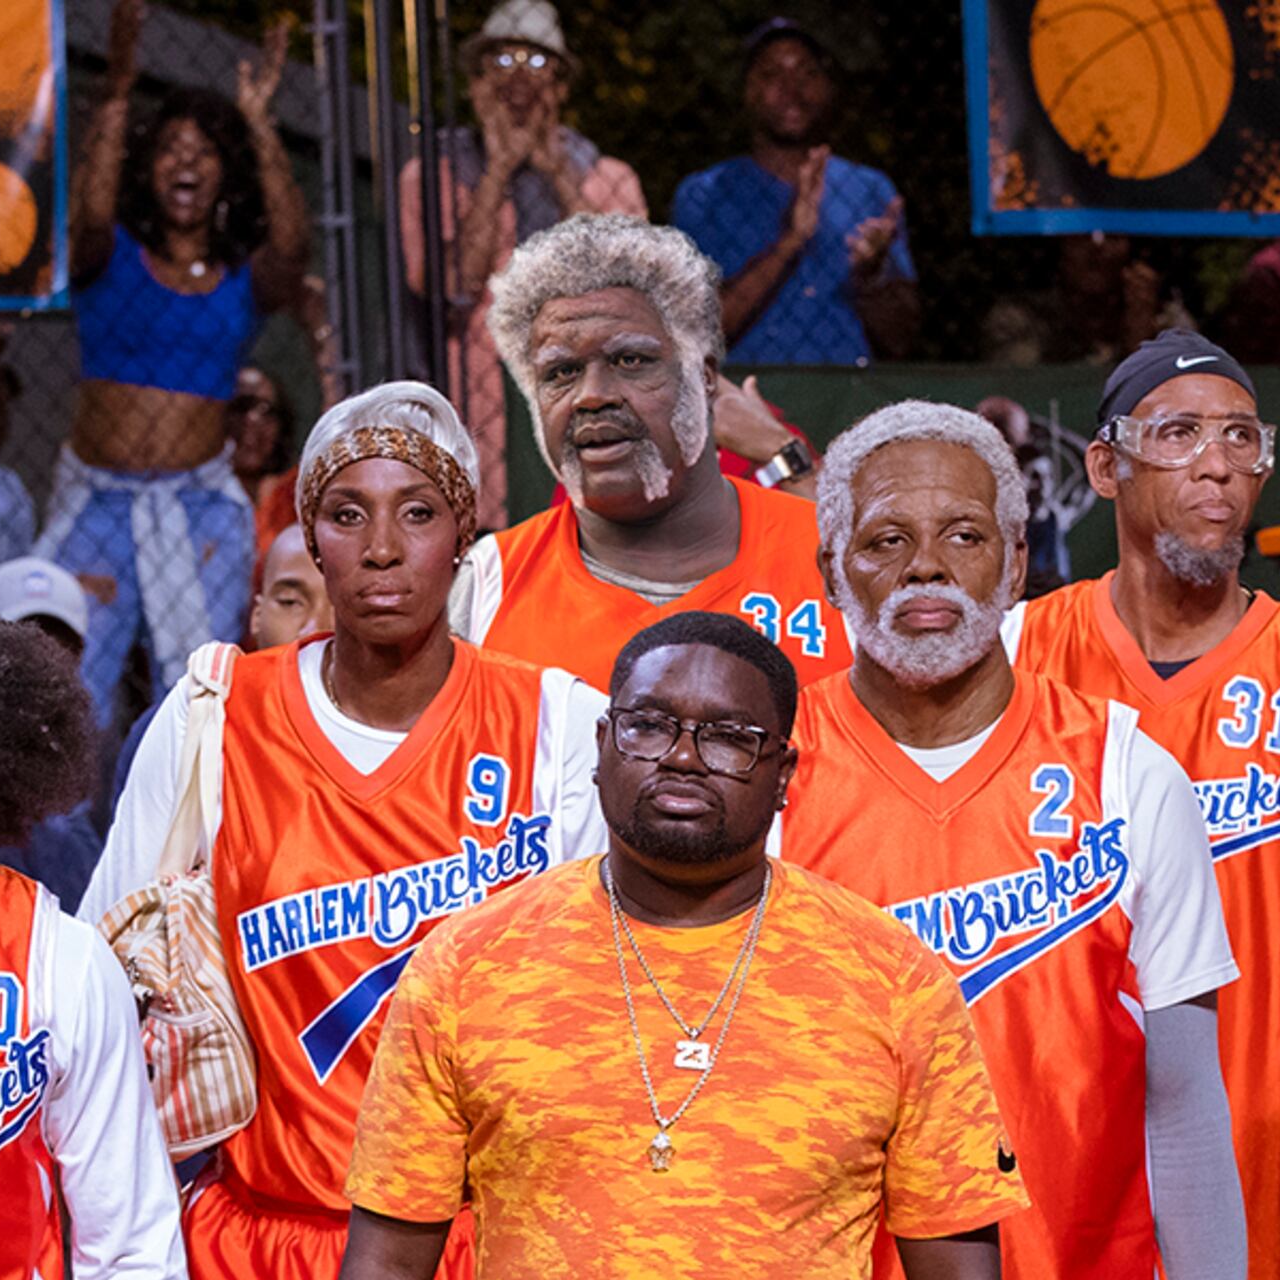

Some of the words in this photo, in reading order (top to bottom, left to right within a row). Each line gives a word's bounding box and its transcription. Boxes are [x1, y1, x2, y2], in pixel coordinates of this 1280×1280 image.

[740, 592, 826, 658] 34
[464, 753, 510, 827] 9
[1028, 763, 1074, 838] 2
[238, 881, 371, 970] HARLEM
[373, 815, 553, 945] Buckets
[948, 817, 1128, 962] Buckets
